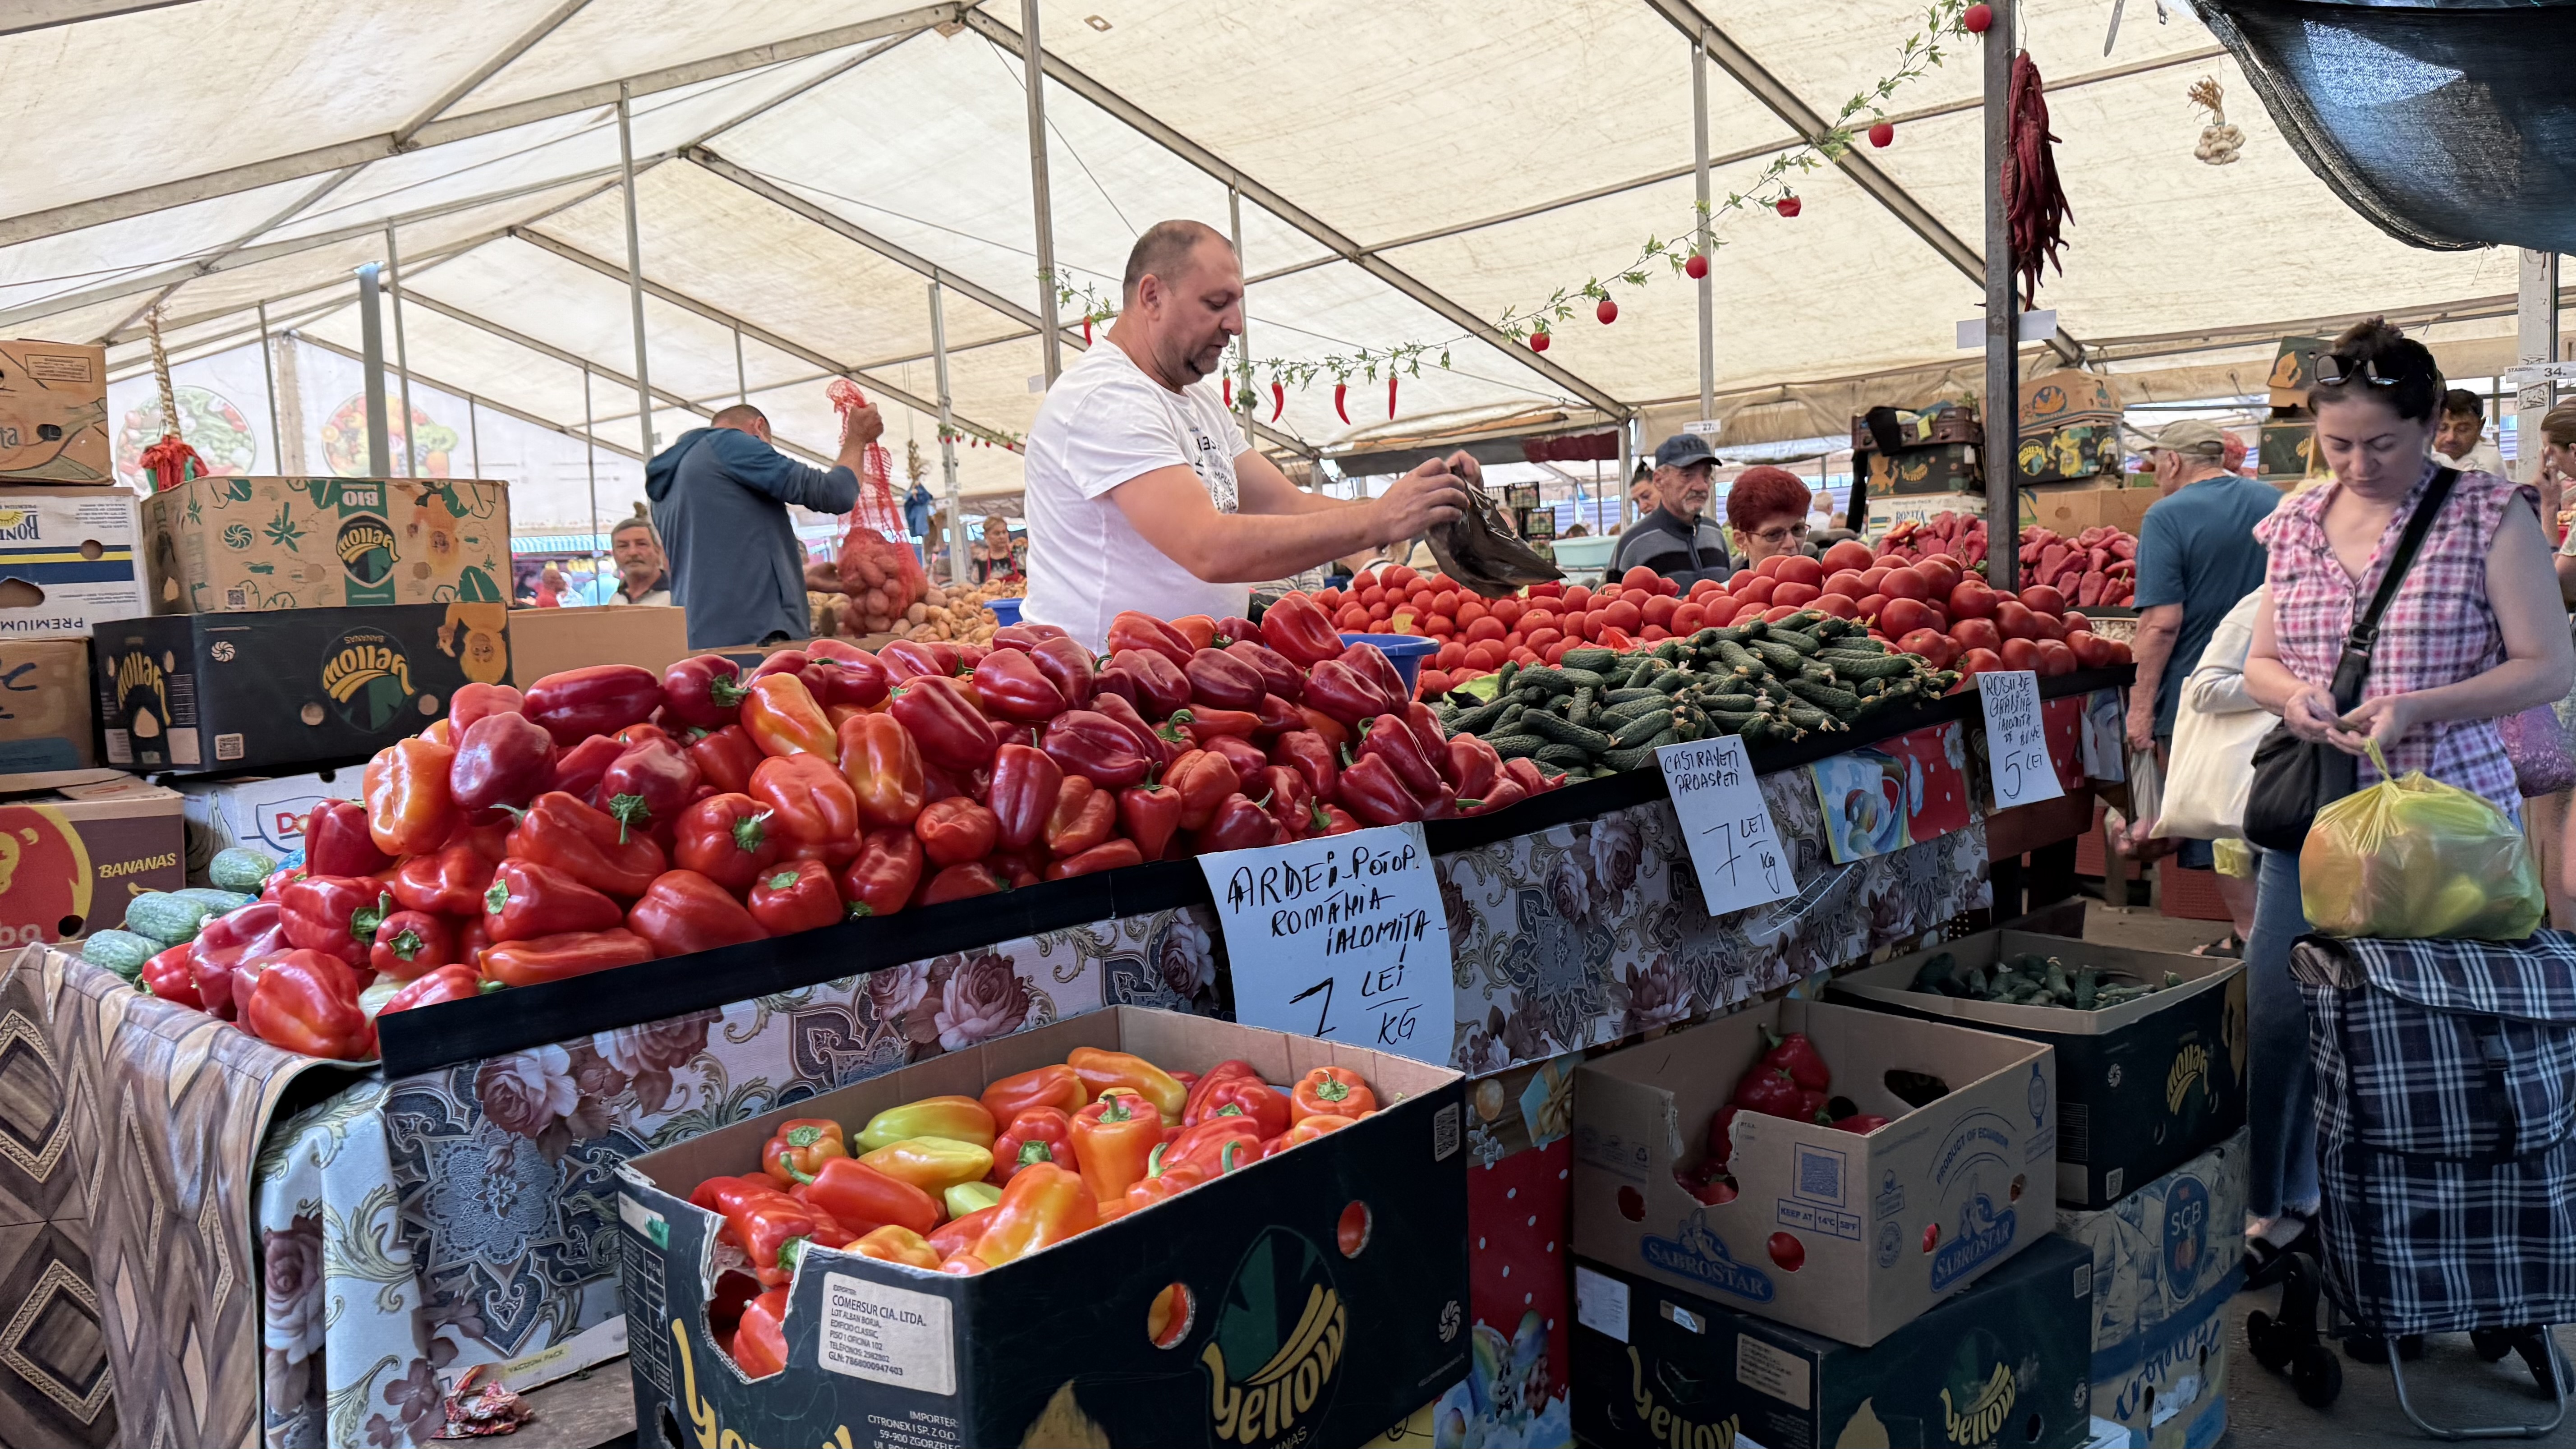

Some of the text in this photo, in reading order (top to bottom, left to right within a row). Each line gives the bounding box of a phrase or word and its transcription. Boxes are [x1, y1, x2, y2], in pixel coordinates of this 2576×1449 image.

[2544, 367, 2567, 377] 34.
[342, 491, 378, 506] BIO
[336, 528, 400, 563] yellow
[0, 617, 83, 631] PREMIUM
[323, 646, 414, 696] yellow
[2003, 750, 2021, 799] 5
[98, 852, 177, 879] BANANAS
[1702, 823, 1741, 887] 7
[1967, 1128, 1978, 1141] OF
[2171, 1201, 2201, 1236] SCB
[1647, 1242, 1765, 1297] SABROSTAR
[1936, 1222, 2010, 1283] SABROSTAR
[833, 1295, 927, 1326] COMERSUR CIA. LTDA.
[1201, 1303, 1346, 1444] yellow
[1940, 1375, 2015, 1446] yellow
